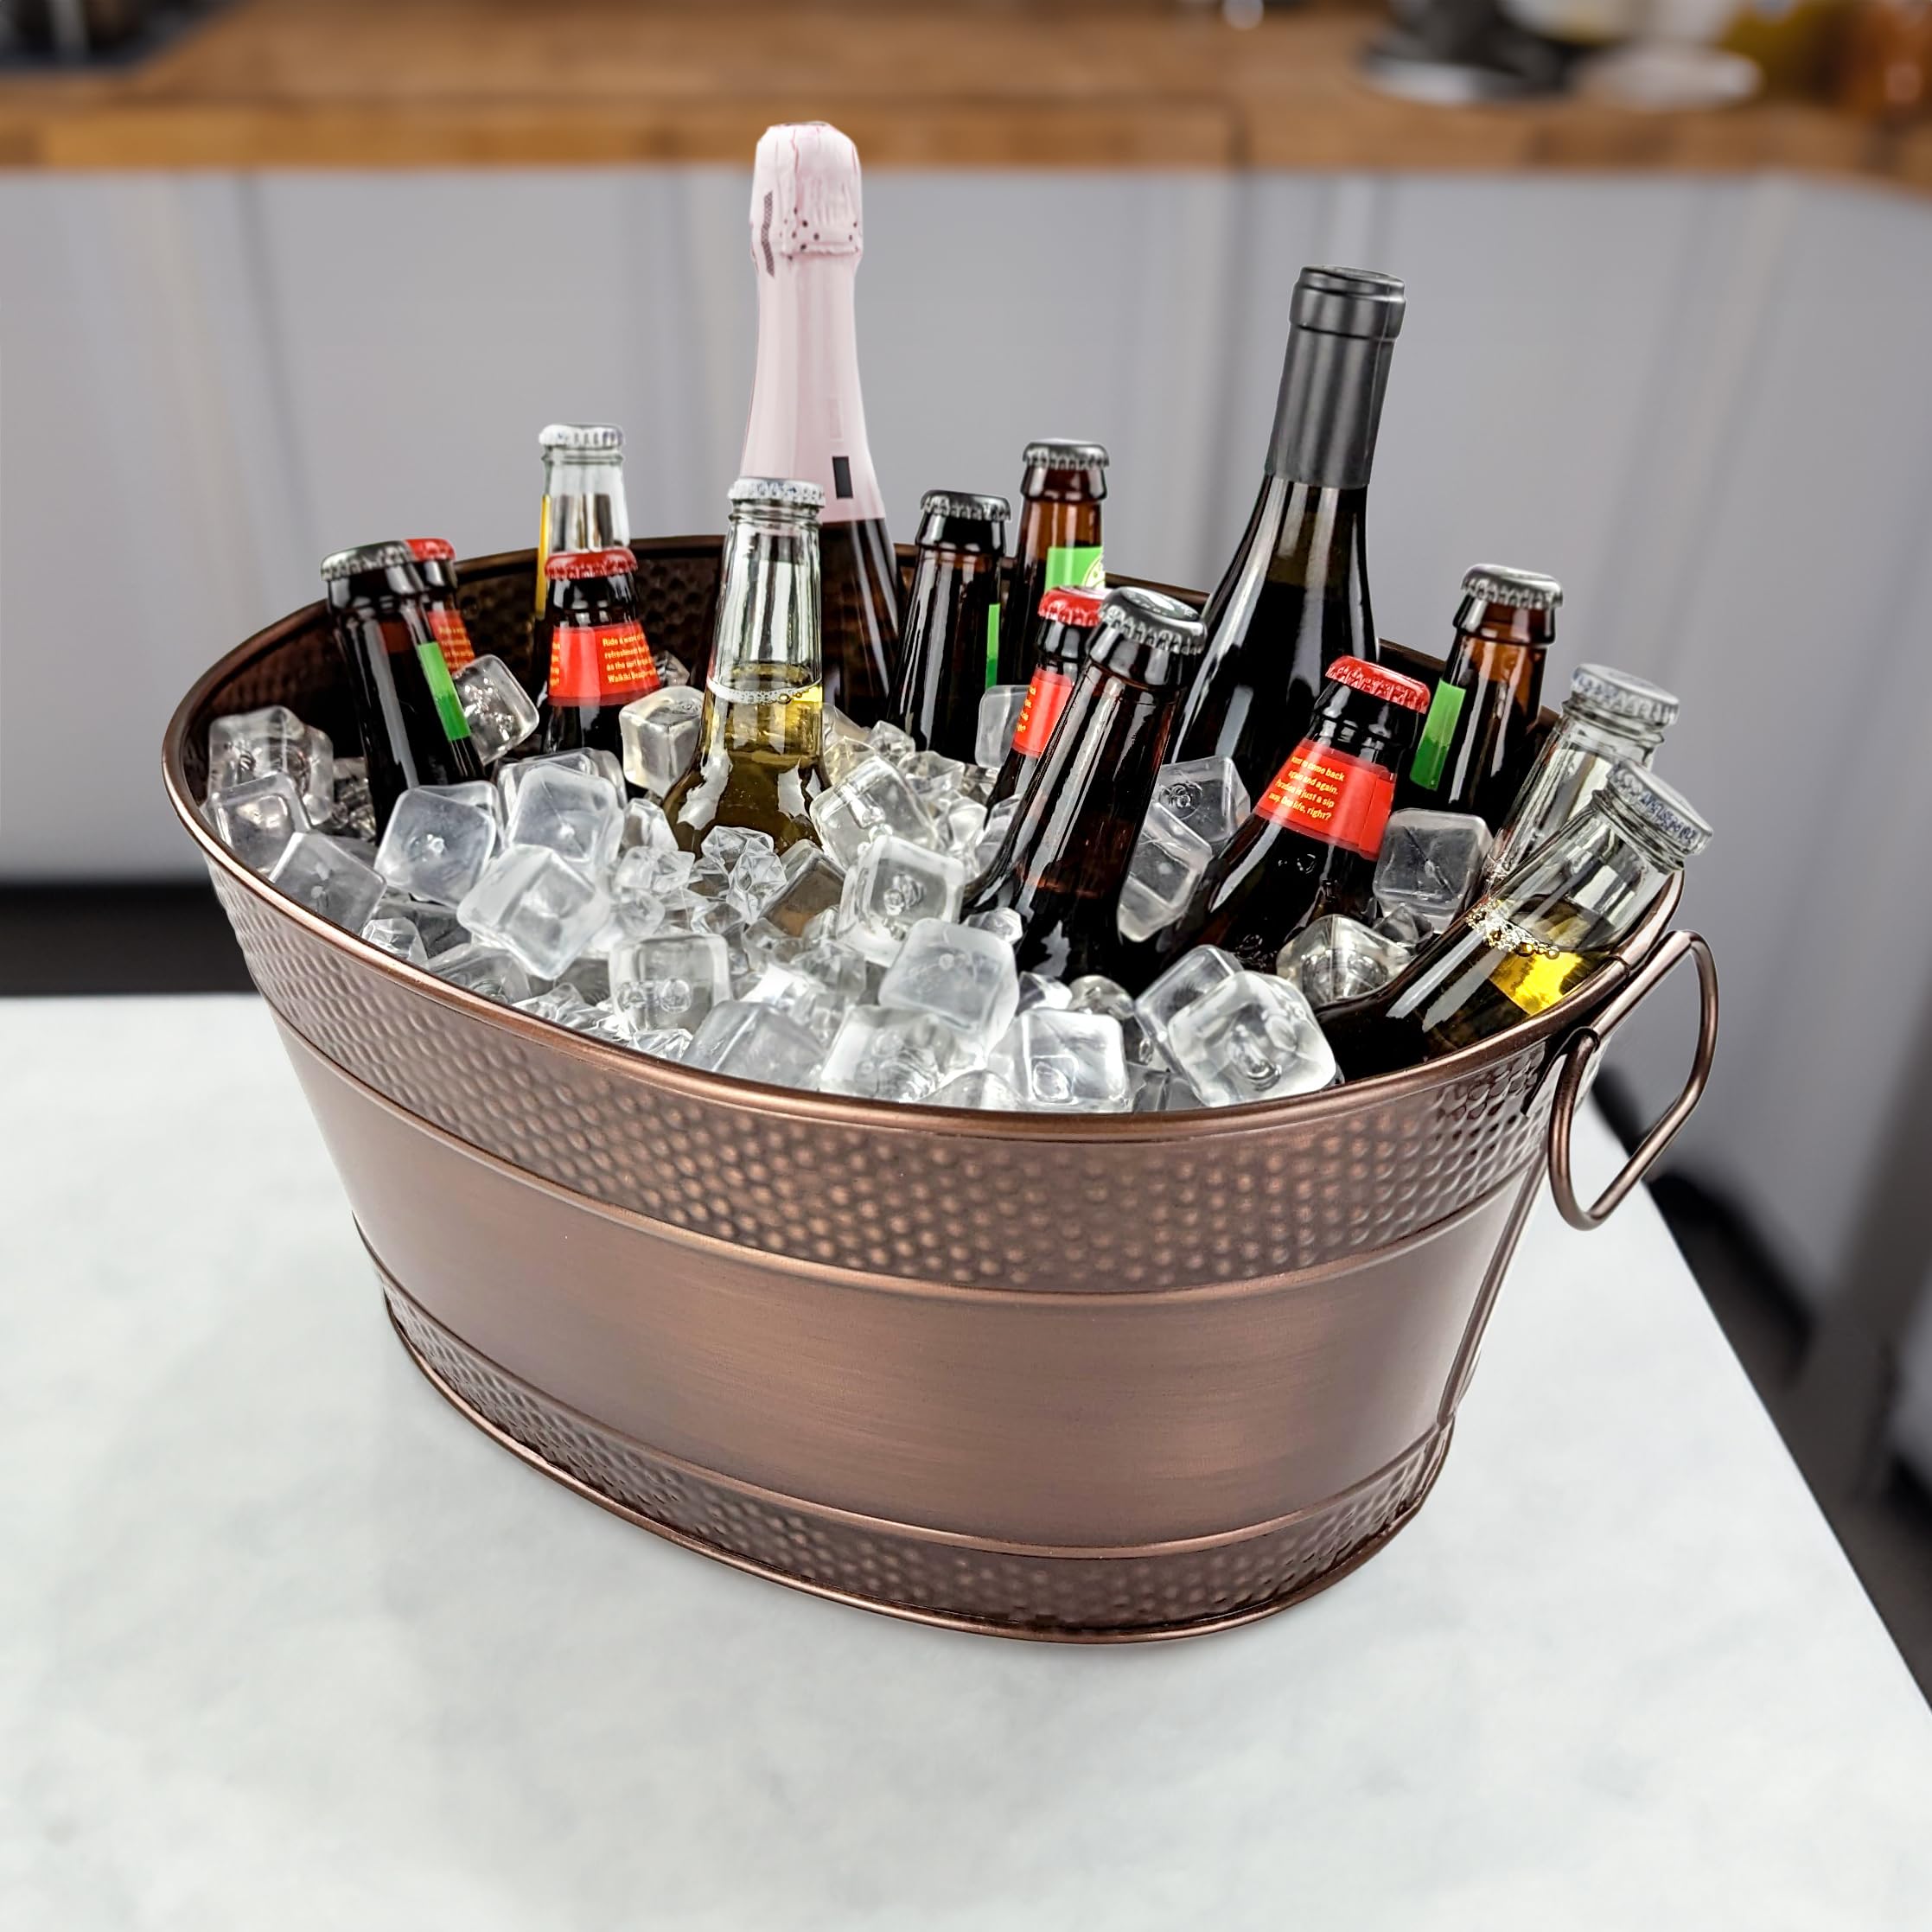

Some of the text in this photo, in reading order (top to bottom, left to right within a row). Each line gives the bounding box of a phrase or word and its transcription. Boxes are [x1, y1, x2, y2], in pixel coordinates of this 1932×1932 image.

[603, 638, 618, 647] Ride
[1302, 775, 1317, 786] and
[1307, 762, 1326, 775] come
[1325, 768, 1345, 782] back
[1280, 795, 1294, 807] One
[1292, 800, 1306, 813] life,
[1306, 807, 1331, 820] right?
[1295, 787, 1303, 796] is
[1300, 789, 1317, 801] just
[1316, 795, 1323, 804] a
[1322, 798, 1335, 809] sip
